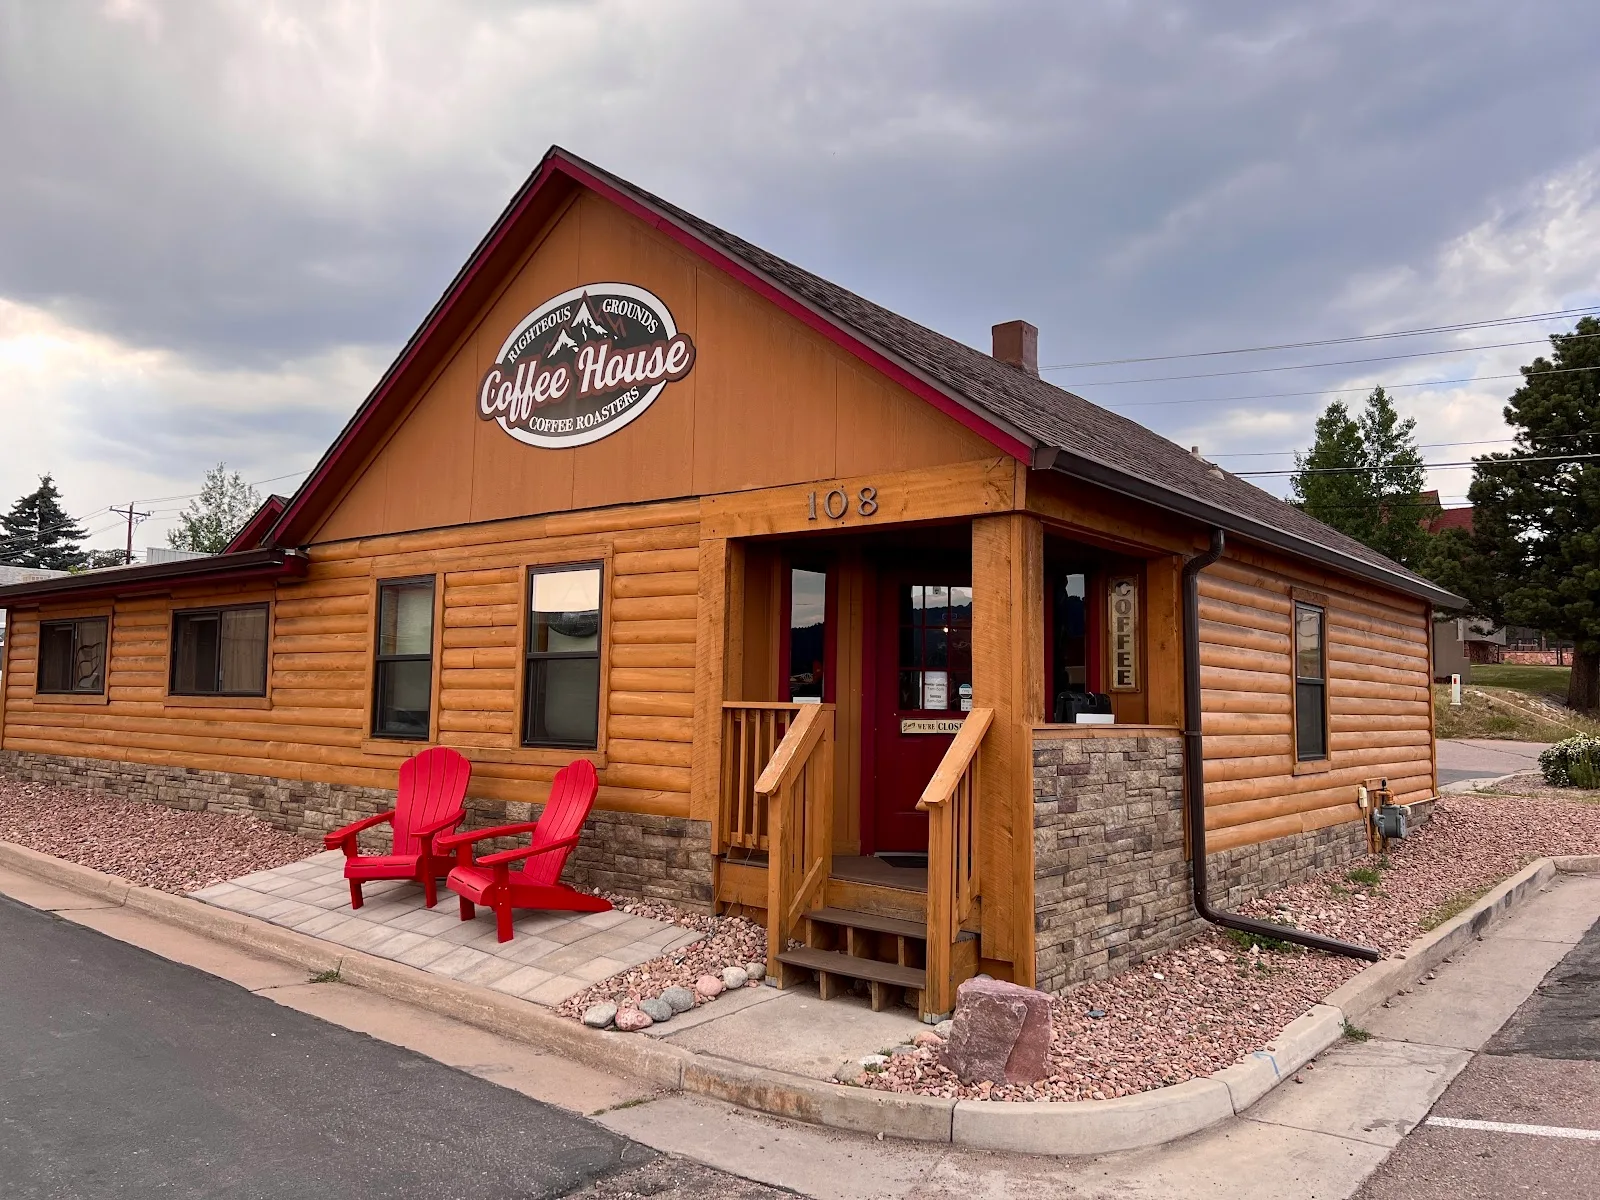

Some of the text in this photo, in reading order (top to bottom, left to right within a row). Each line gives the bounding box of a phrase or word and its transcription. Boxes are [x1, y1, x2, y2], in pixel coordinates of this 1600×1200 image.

[507, 298, 658, 364] RIGHTEOUS GROUNDS
[480, 340, 690, 423] Coffee House
[529, 386, 640, 433] COFFEE ROASTERS
[807, 487, 879, 521] 108
[1114, 581, 1132, 686] COFFEE
